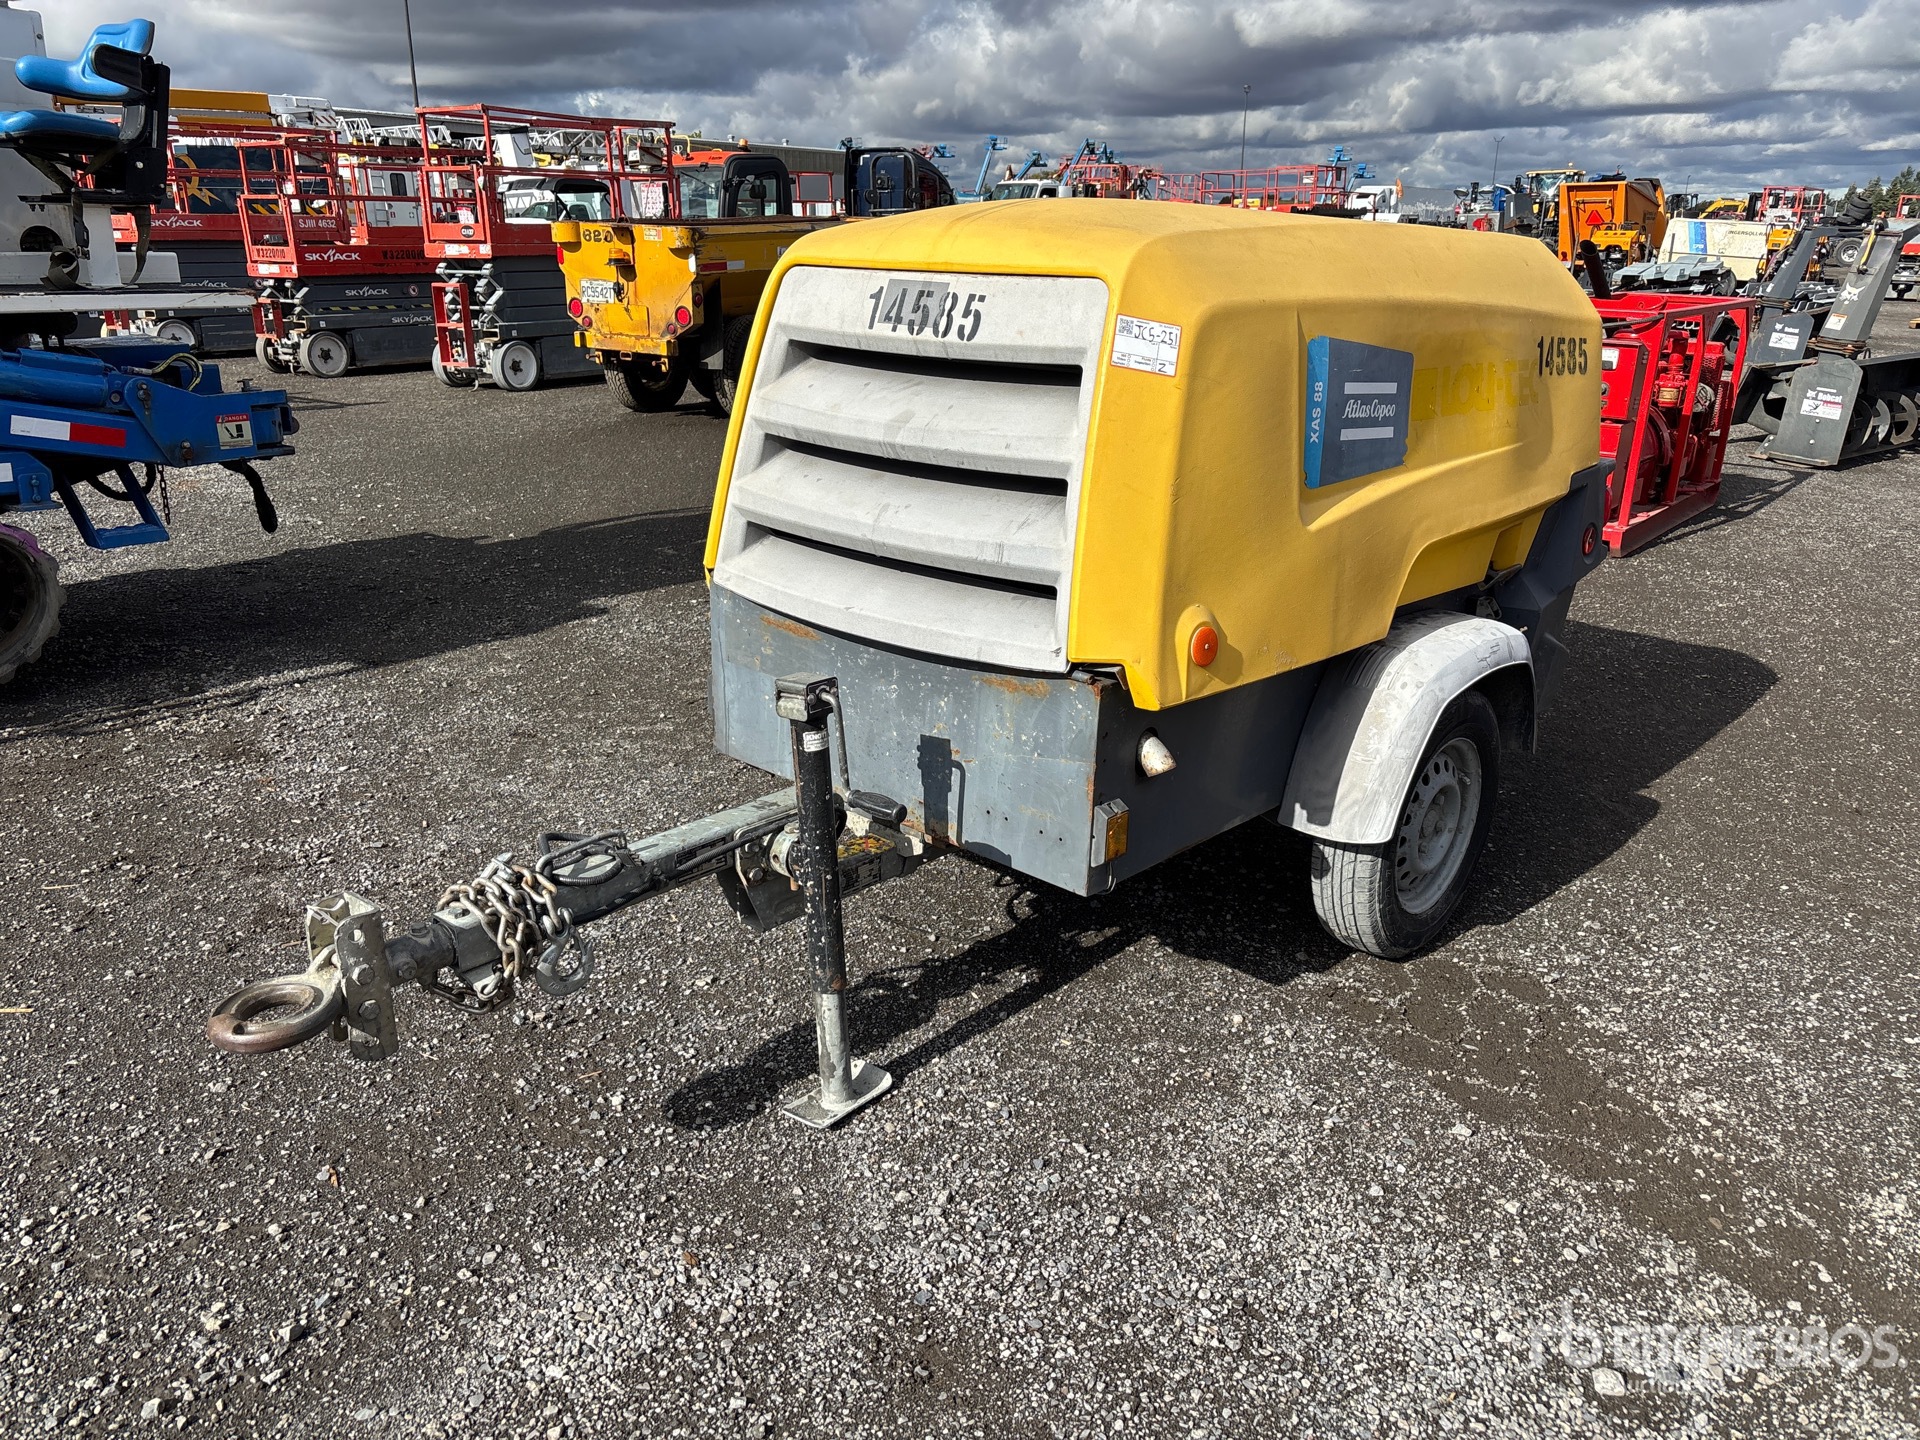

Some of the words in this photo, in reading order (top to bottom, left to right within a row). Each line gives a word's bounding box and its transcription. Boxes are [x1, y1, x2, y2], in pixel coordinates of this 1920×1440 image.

[151, 216, 203, 228] SKYJACK
[318, 220, 336, 228] 4632
[304, 249, 361, 262] SKYJACK
[344, 286, 389, 296] SKYJACK
[391, 314, 433, 323] SKYJACK
[867, 286, 987, 342] 14585
[1537, 335, 1588, 377] 14585
[1313, 381, 1323, 402] 88
[1817, 392, 1842, 403] Bobcat
[1342, 399, 1371, 419] Atlas
[1370, 398, 1396, 421] Copco
[1309, 407, 1321, 444] XAS
